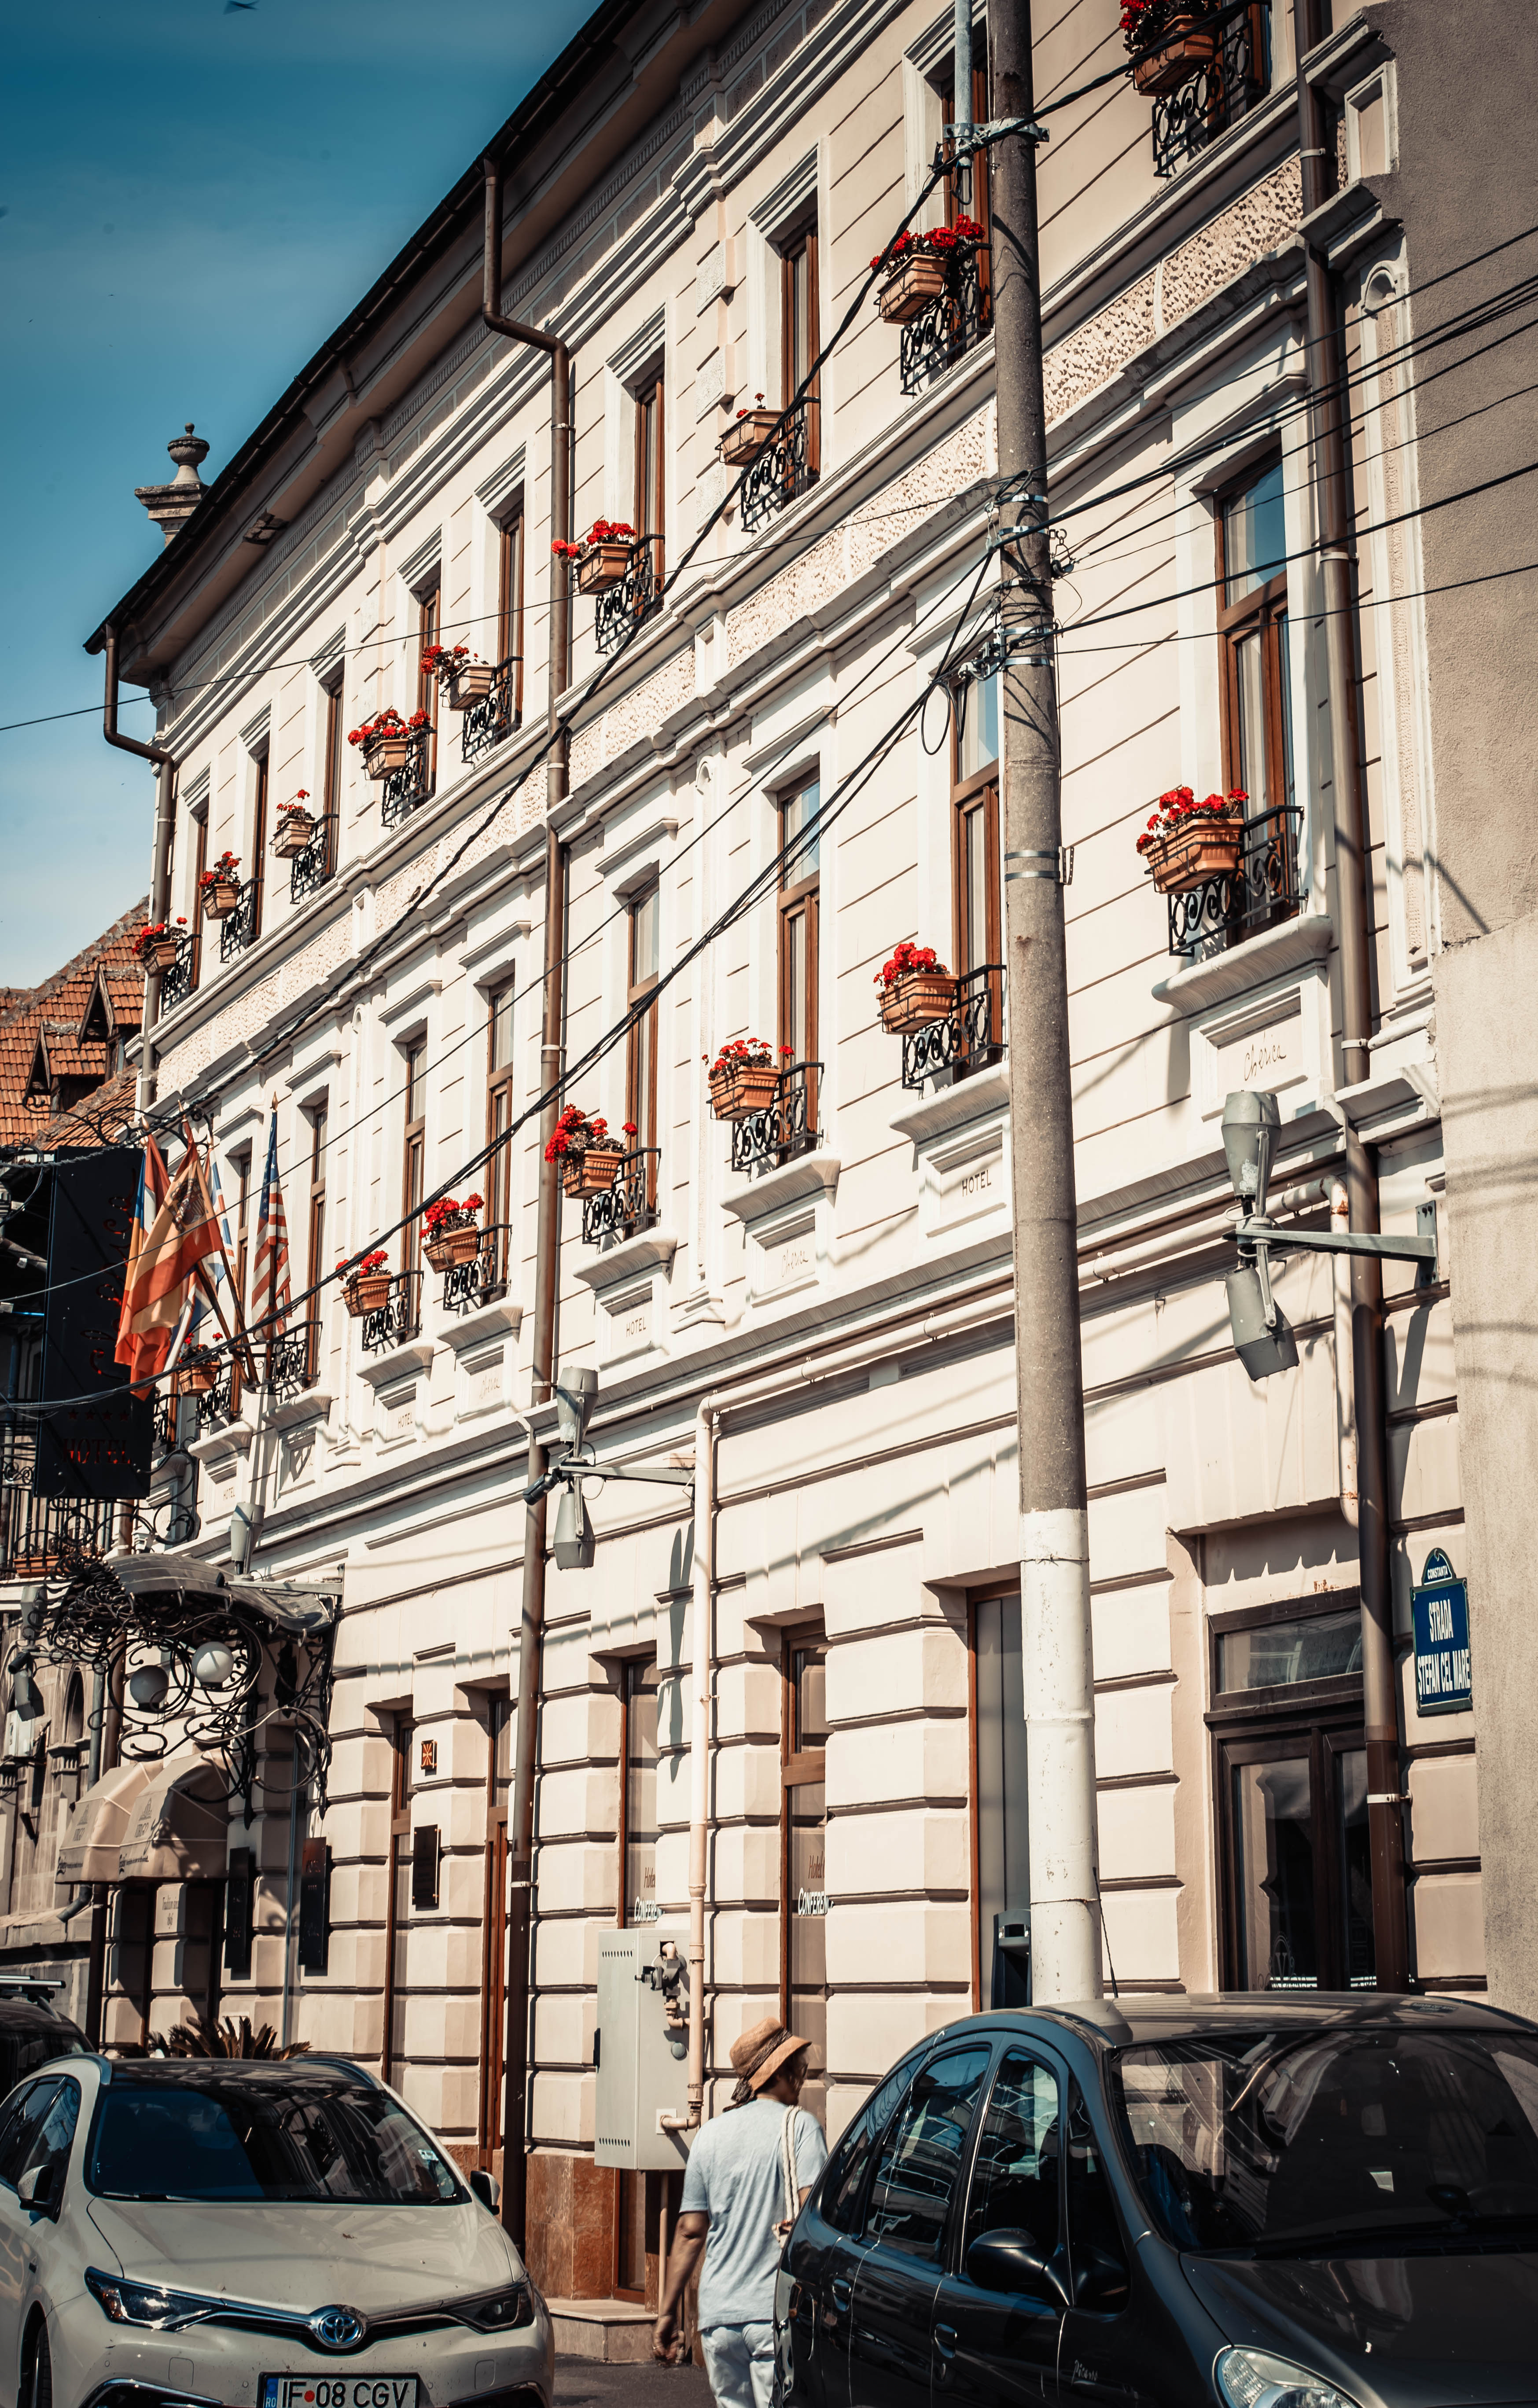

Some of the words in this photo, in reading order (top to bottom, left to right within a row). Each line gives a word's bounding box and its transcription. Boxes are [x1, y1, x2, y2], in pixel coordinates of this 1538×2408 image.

[962, 1169, 992, 1197] HOTEL
[626, 1316, 646, 1338] HOTEL
[397, 1412, 413, 1430] HOTEL
[63, 1438, 132, 1464] HOTEL
[223, 1486, 235, 1501] HOTEL
[1429, 1599, 1453, 1643] STRADA
[1440, 1651, 1453, 1693] CEL
[1453, 1648, 1471, 1690] MARE
[808, 1850, 823, 1879] Hotel
[265, 2397, 276, 2408] RO
[316, 2382, 346, 2408] 08
[353, 2382, 408, 2408] CGV
